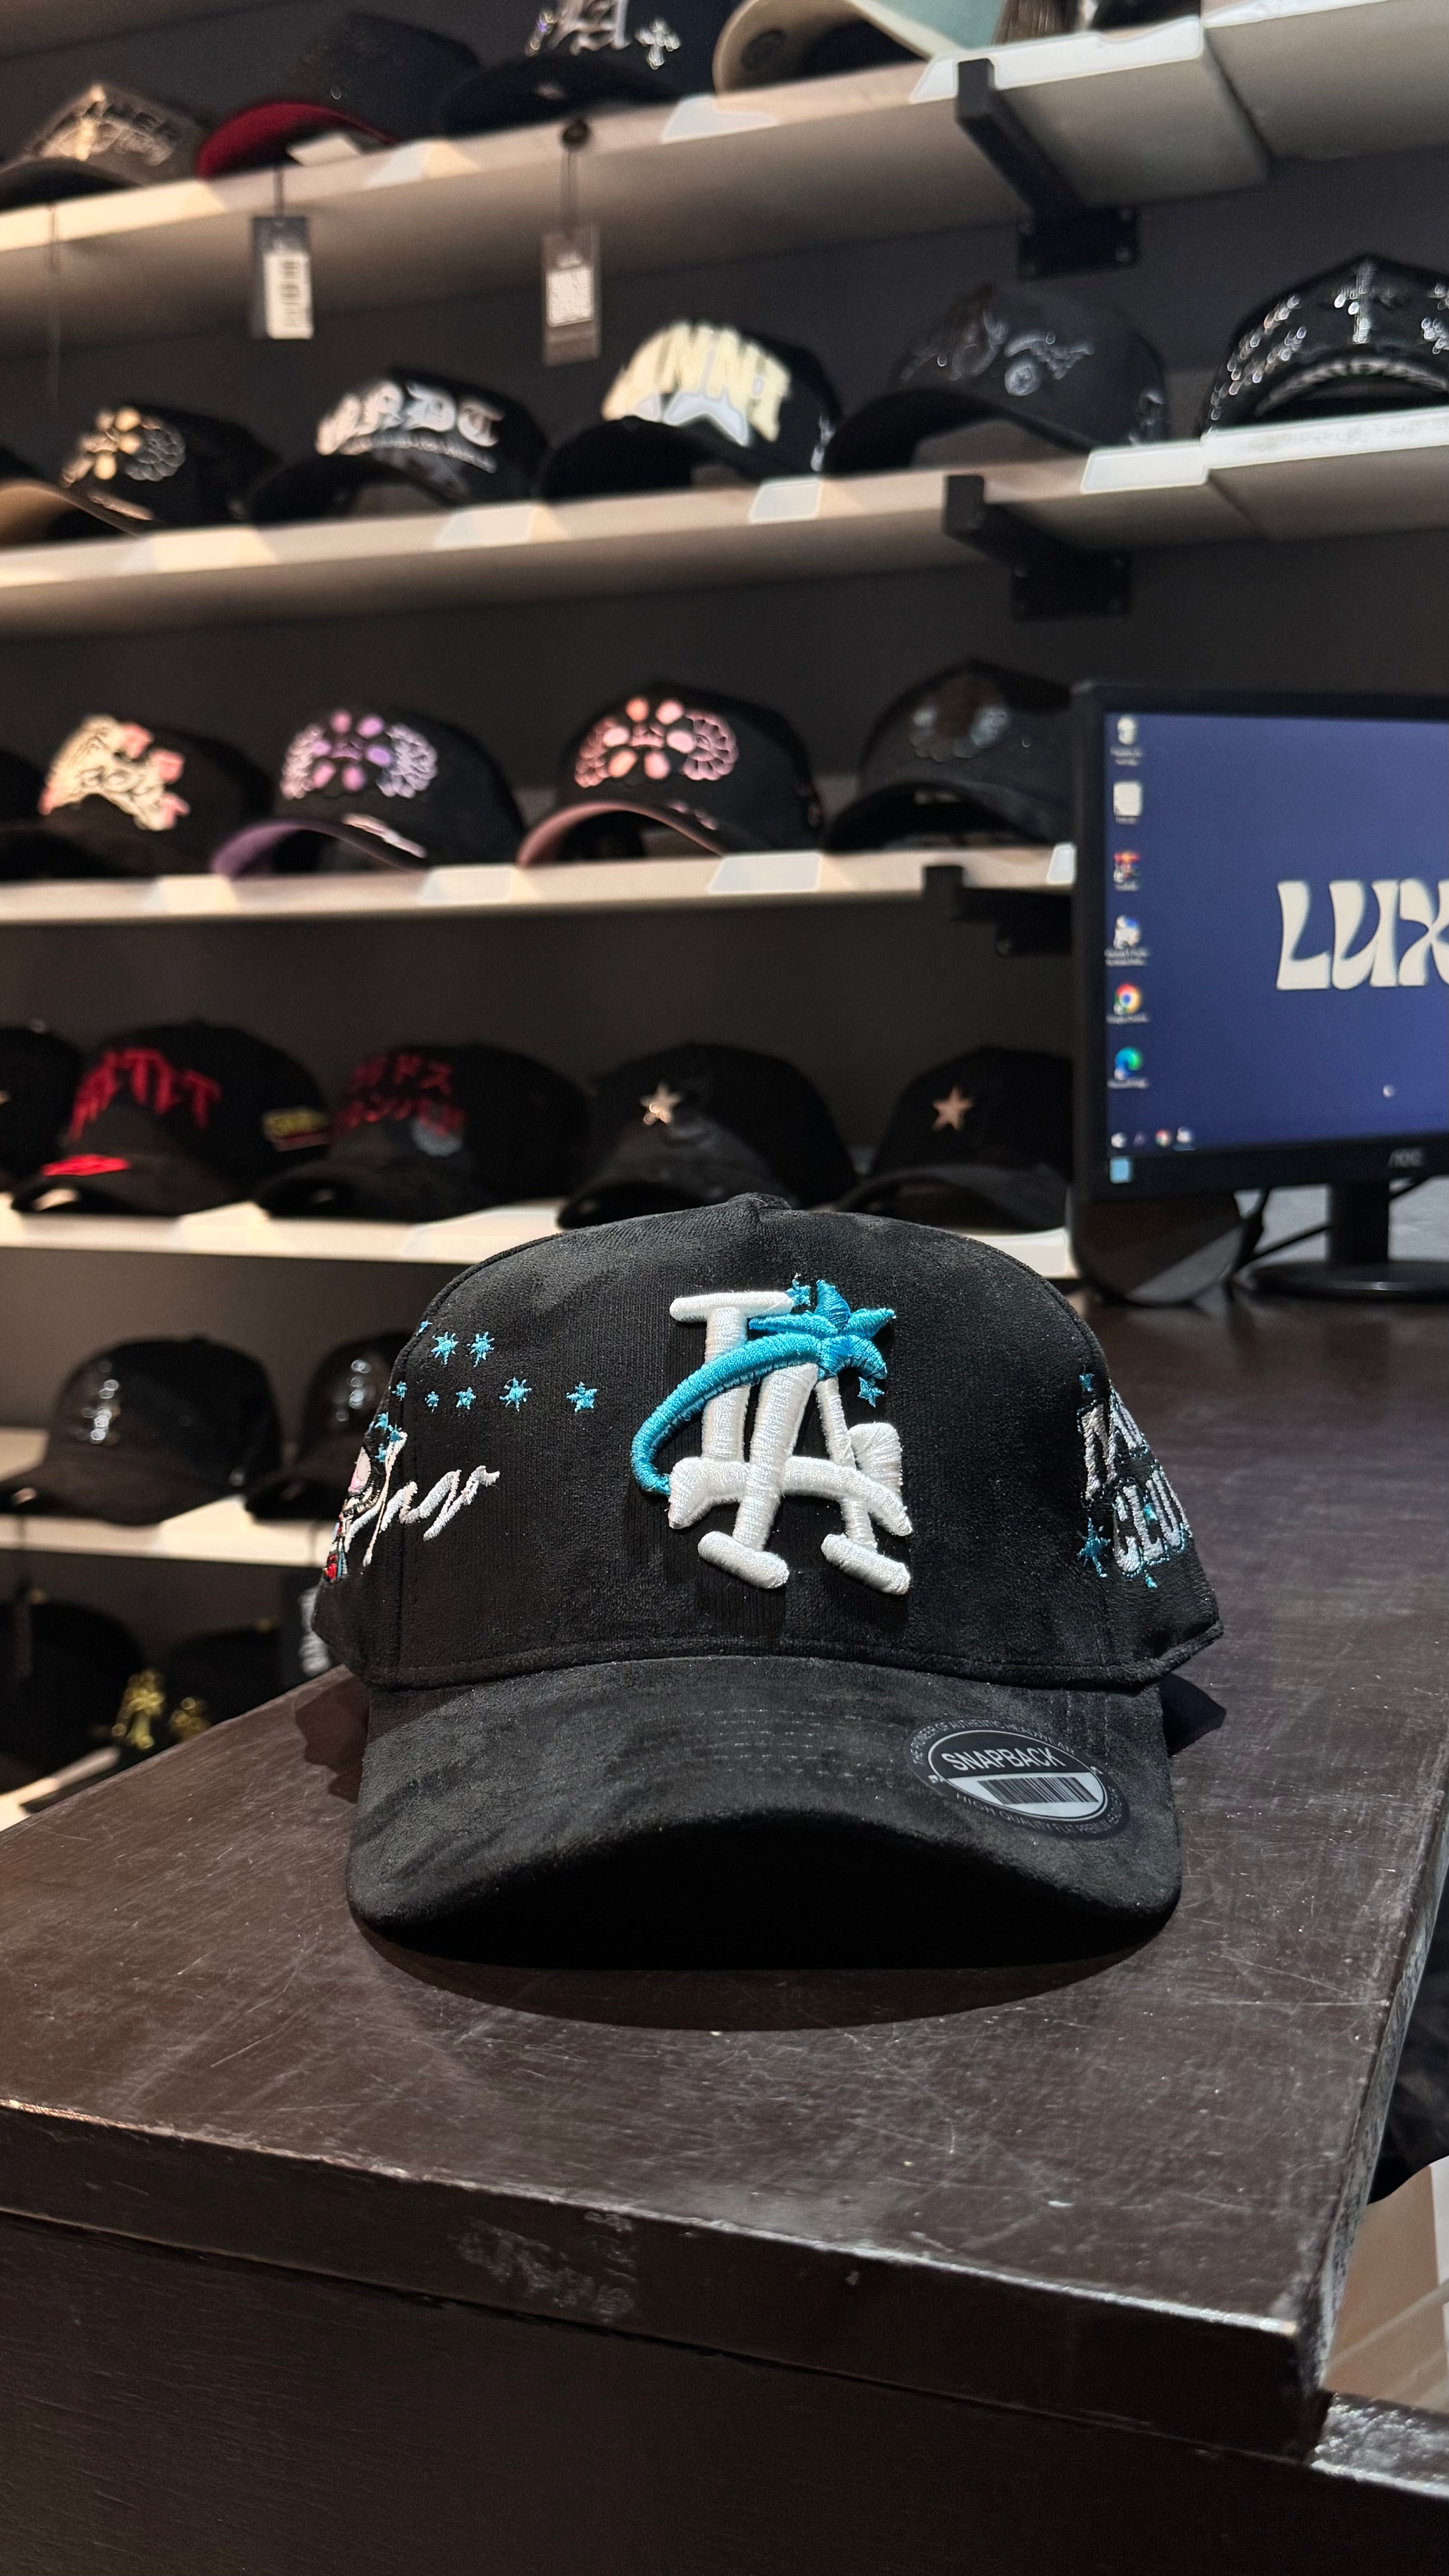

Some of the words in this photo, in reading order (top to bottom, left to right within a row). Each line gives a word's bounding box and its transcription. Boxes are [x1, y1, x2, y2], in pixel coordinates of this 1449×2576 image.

[1276, 878, 1449, 990] LUX
[910, 1725, 937, 1750] PIONEER
[934, 1721, 948, 1732] OF
[910, 1748, 925, 1765] THE
[941, 1747, 1067, 1771] SNAPBACK
[956, 1792, 997, 1817] HIGH
